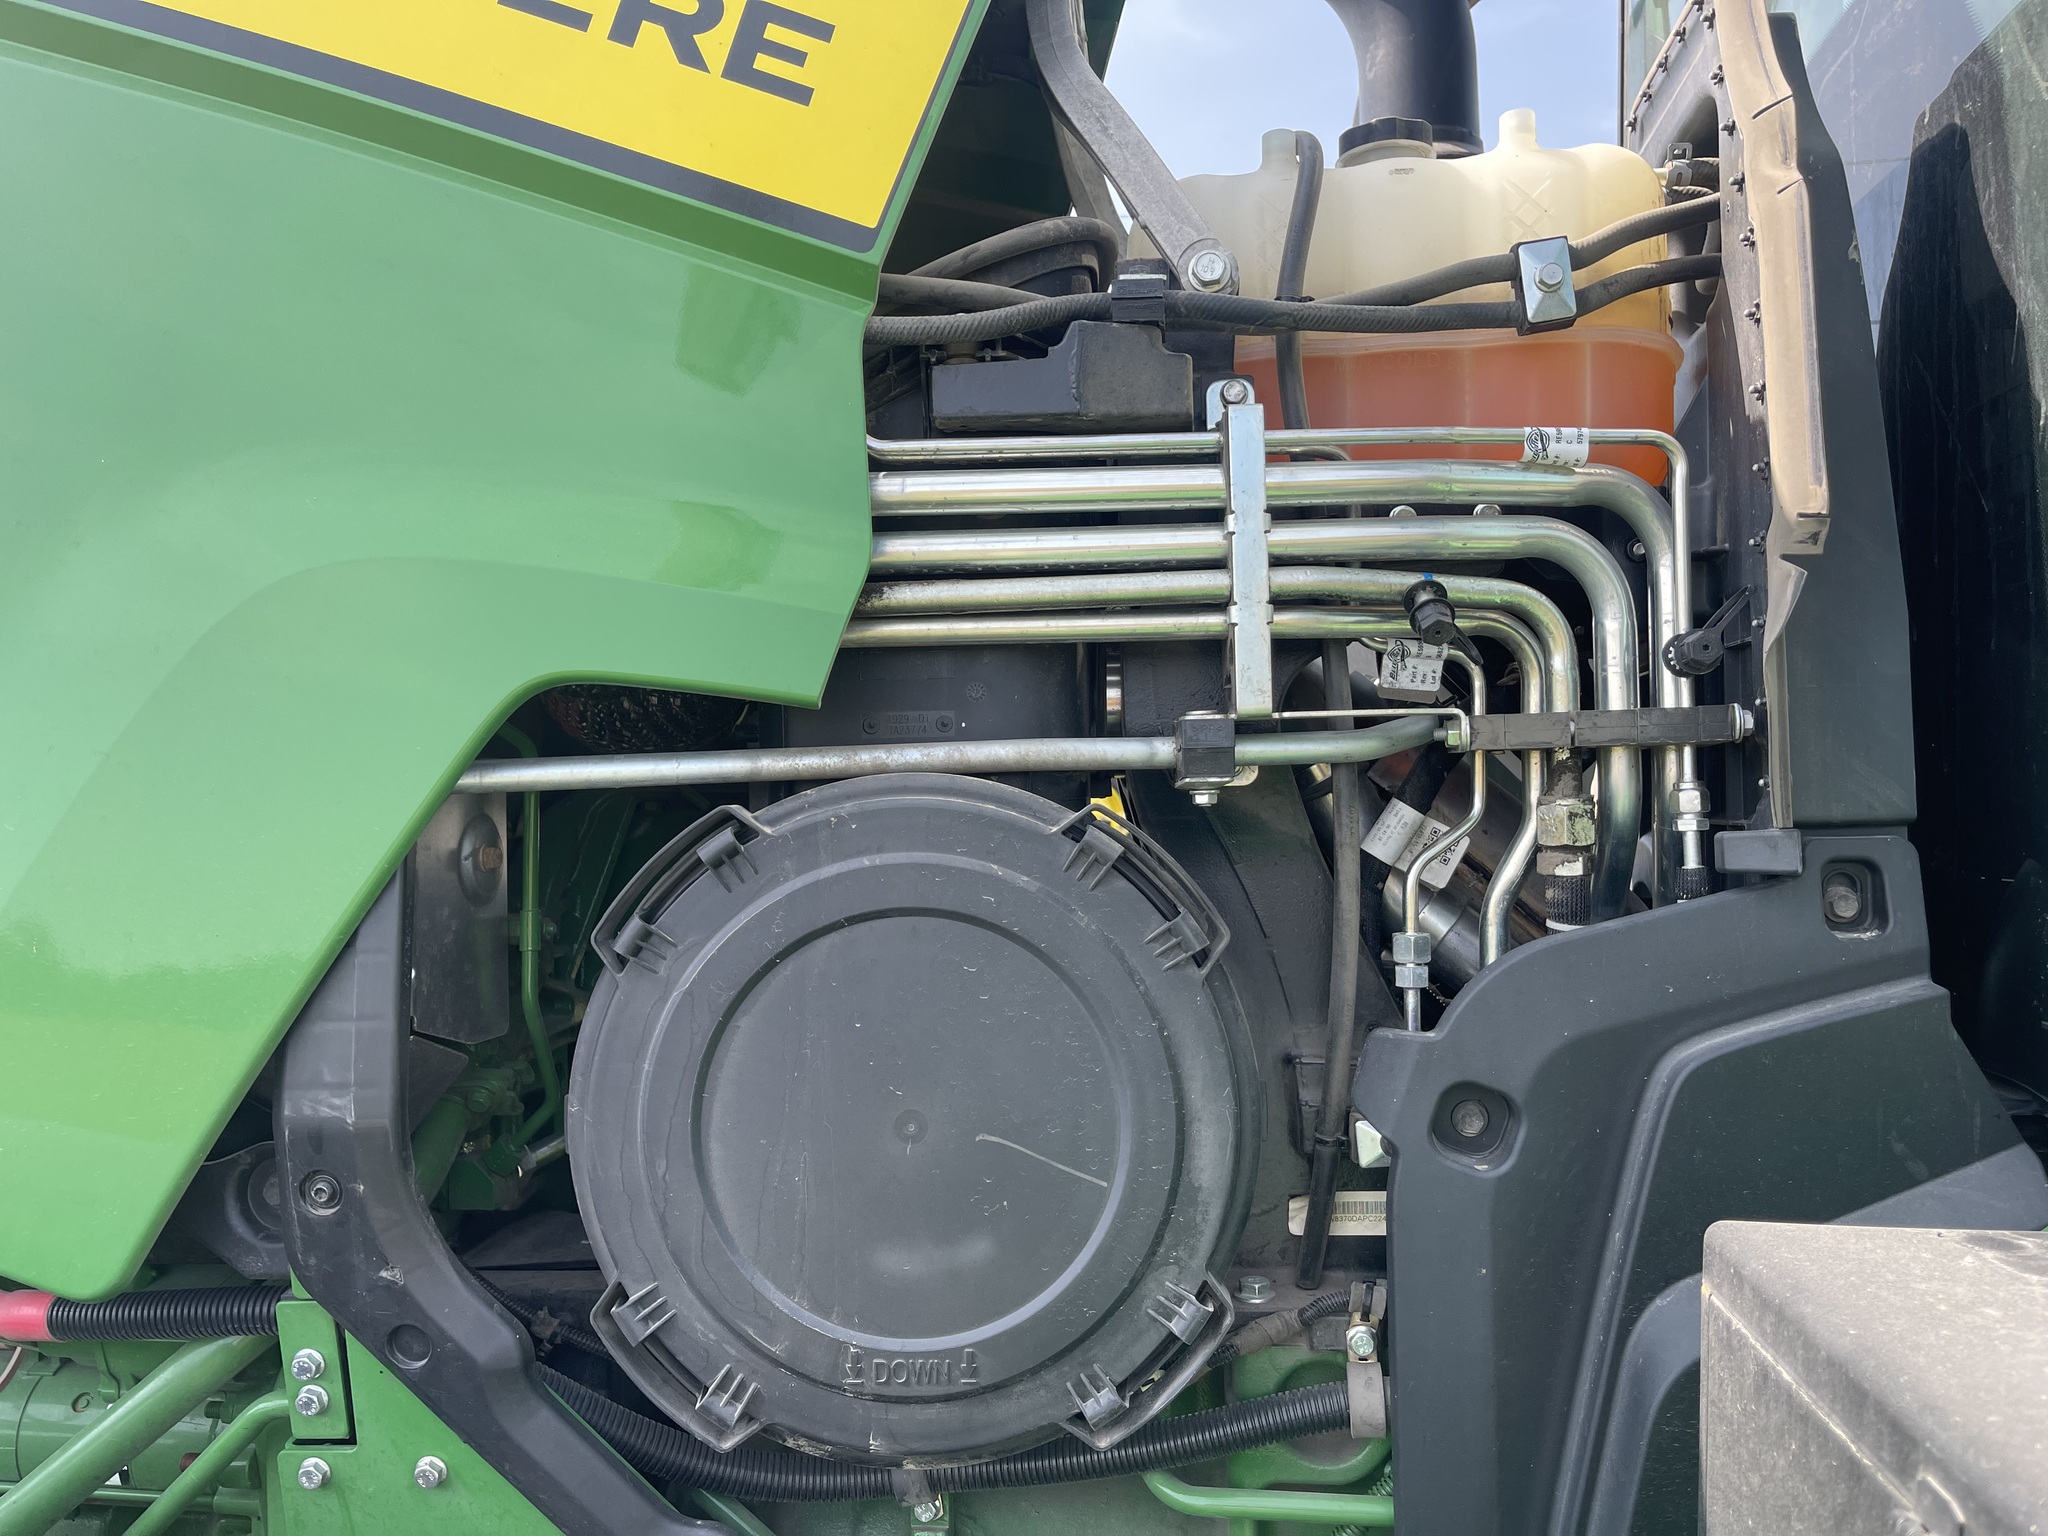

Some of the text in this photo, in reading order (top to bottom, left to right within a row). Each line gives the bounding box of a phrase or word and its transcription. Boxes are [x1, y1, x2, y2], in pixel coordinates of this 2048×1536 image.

[497, 0, 836, 107] RE
[1381, 352, 1441, 370] COLD
[1410, 670, 1418, 683] Part
[872, 1359, 951, 1384] DOWN
